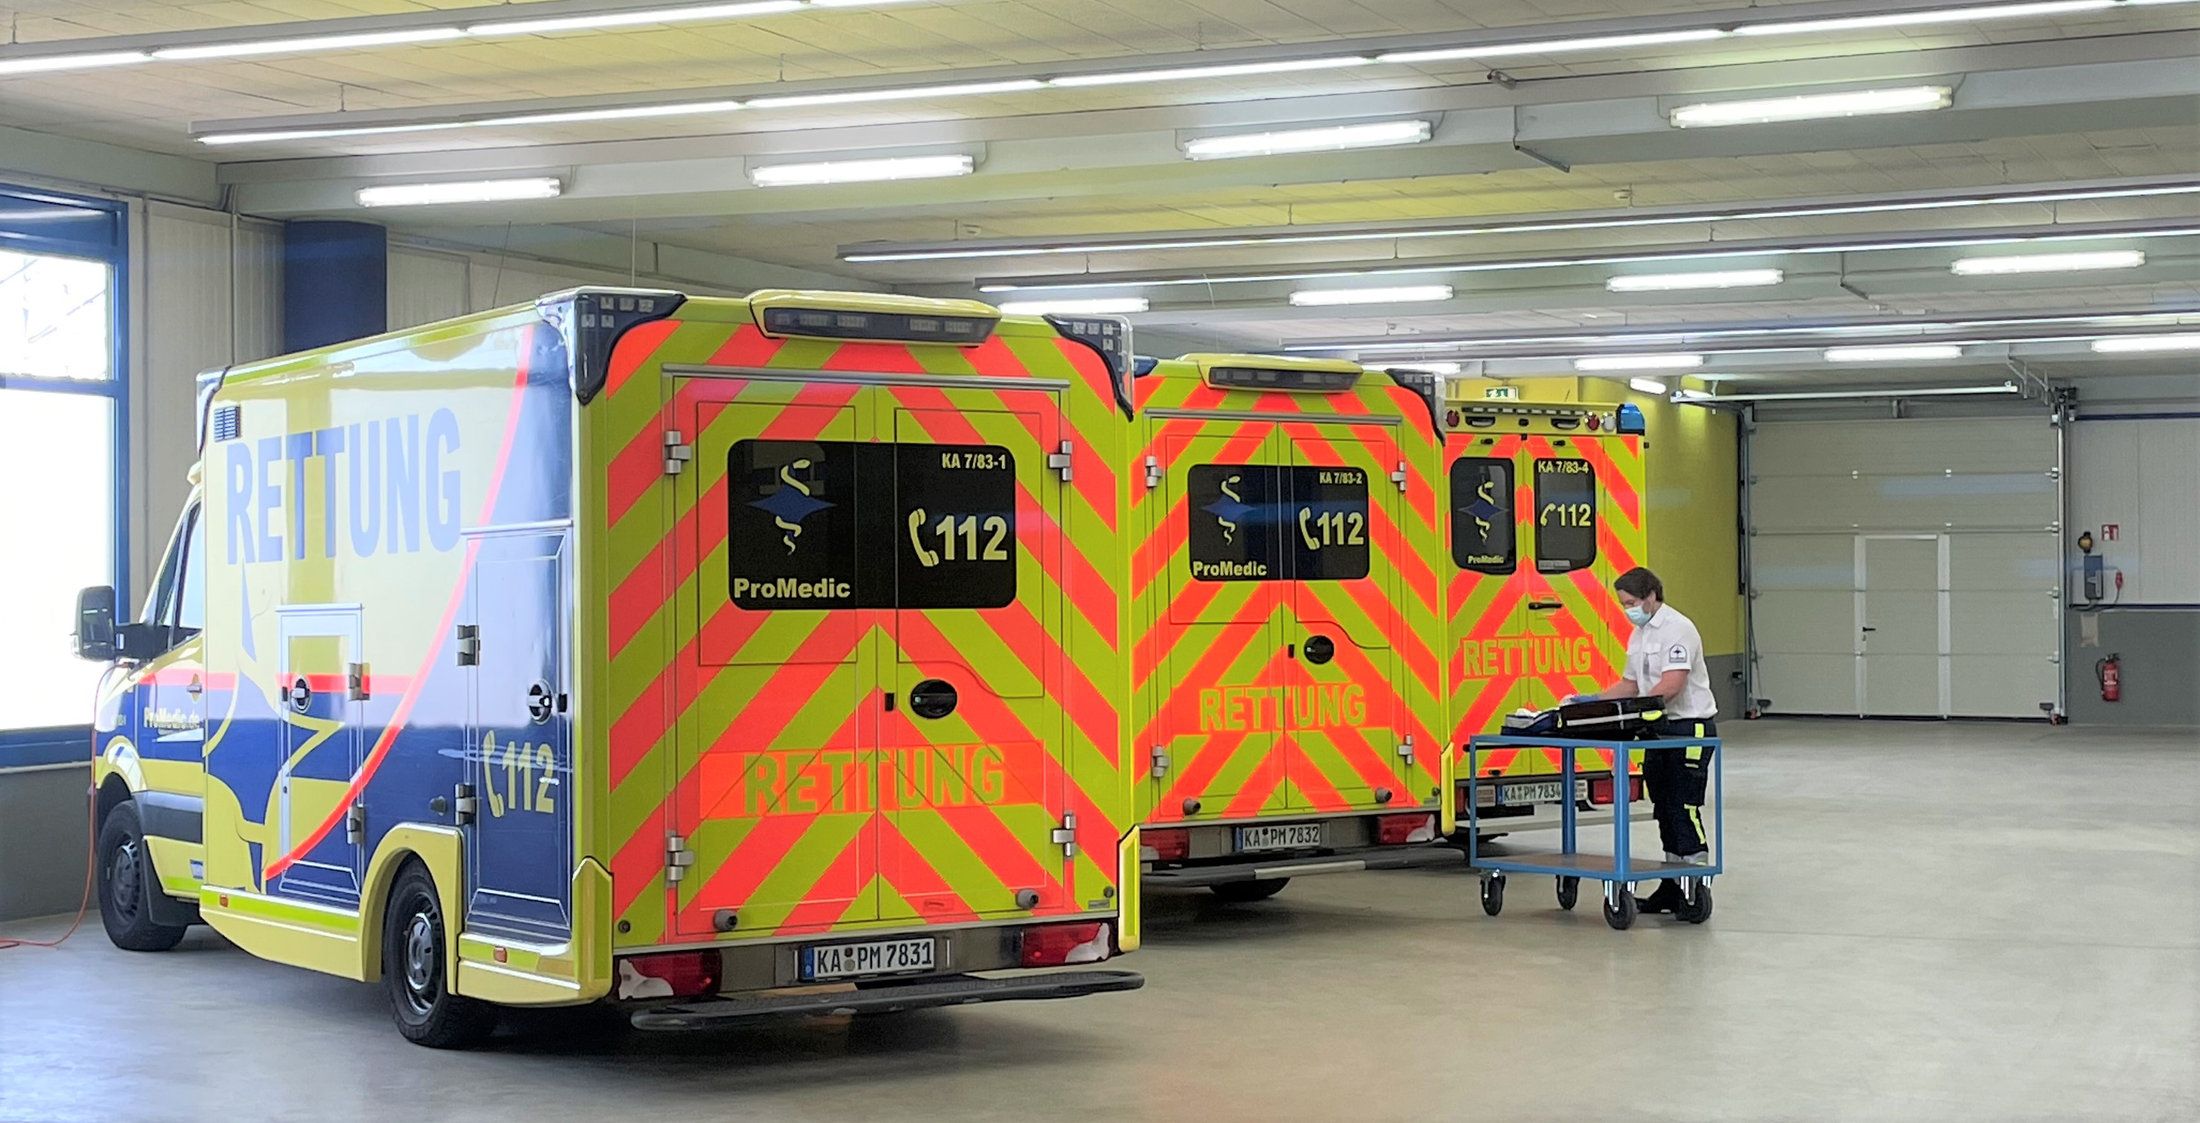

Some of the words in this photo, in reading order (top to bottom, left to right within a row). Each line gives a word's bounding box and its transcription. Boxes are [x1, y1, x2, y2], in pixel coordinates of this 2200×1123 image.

[942, 453, 960, 469] KA
[964, 453, 1006, 470] 7/83-1
[1538, 461, 1554, 473] KA
[1556, 461, 1589, 474] 7/83-4
[227, 407, 461, 565] RETTUNG
[1319, 472, 1333, 484] KA
[1334, 472, 1363, 485] 7/83-2
[1558, 504, 1591, 526] 112
[936, 515, 1007, 560] 112
[1317, 512, 1364, 545] 112
[1193, 561, 1267, 577] ProMedic
[1467, 555, 1504, 564] ProMedic
[734, 578, 851, 599] ProMedic
[1463, 635, 1591, 676] RETTUNG
[1200, 684, 1366, 731] RETTUNG
[502, 741, 554, 813] 112
[744, 745, 1003, 816] RETTUNG
[1504, 786, 1516, 800] KA
[1524, 785, 1536, 800] PM
[1245, 829, 1260, 847] KA
[1271, 828, 1286, 845] PM
[1289, 826, 1319, 843] 7832
[818, 949, 841, 974] KA
[858, 946, 881, 970] PM
[887, 942, 932, 967] 7831
